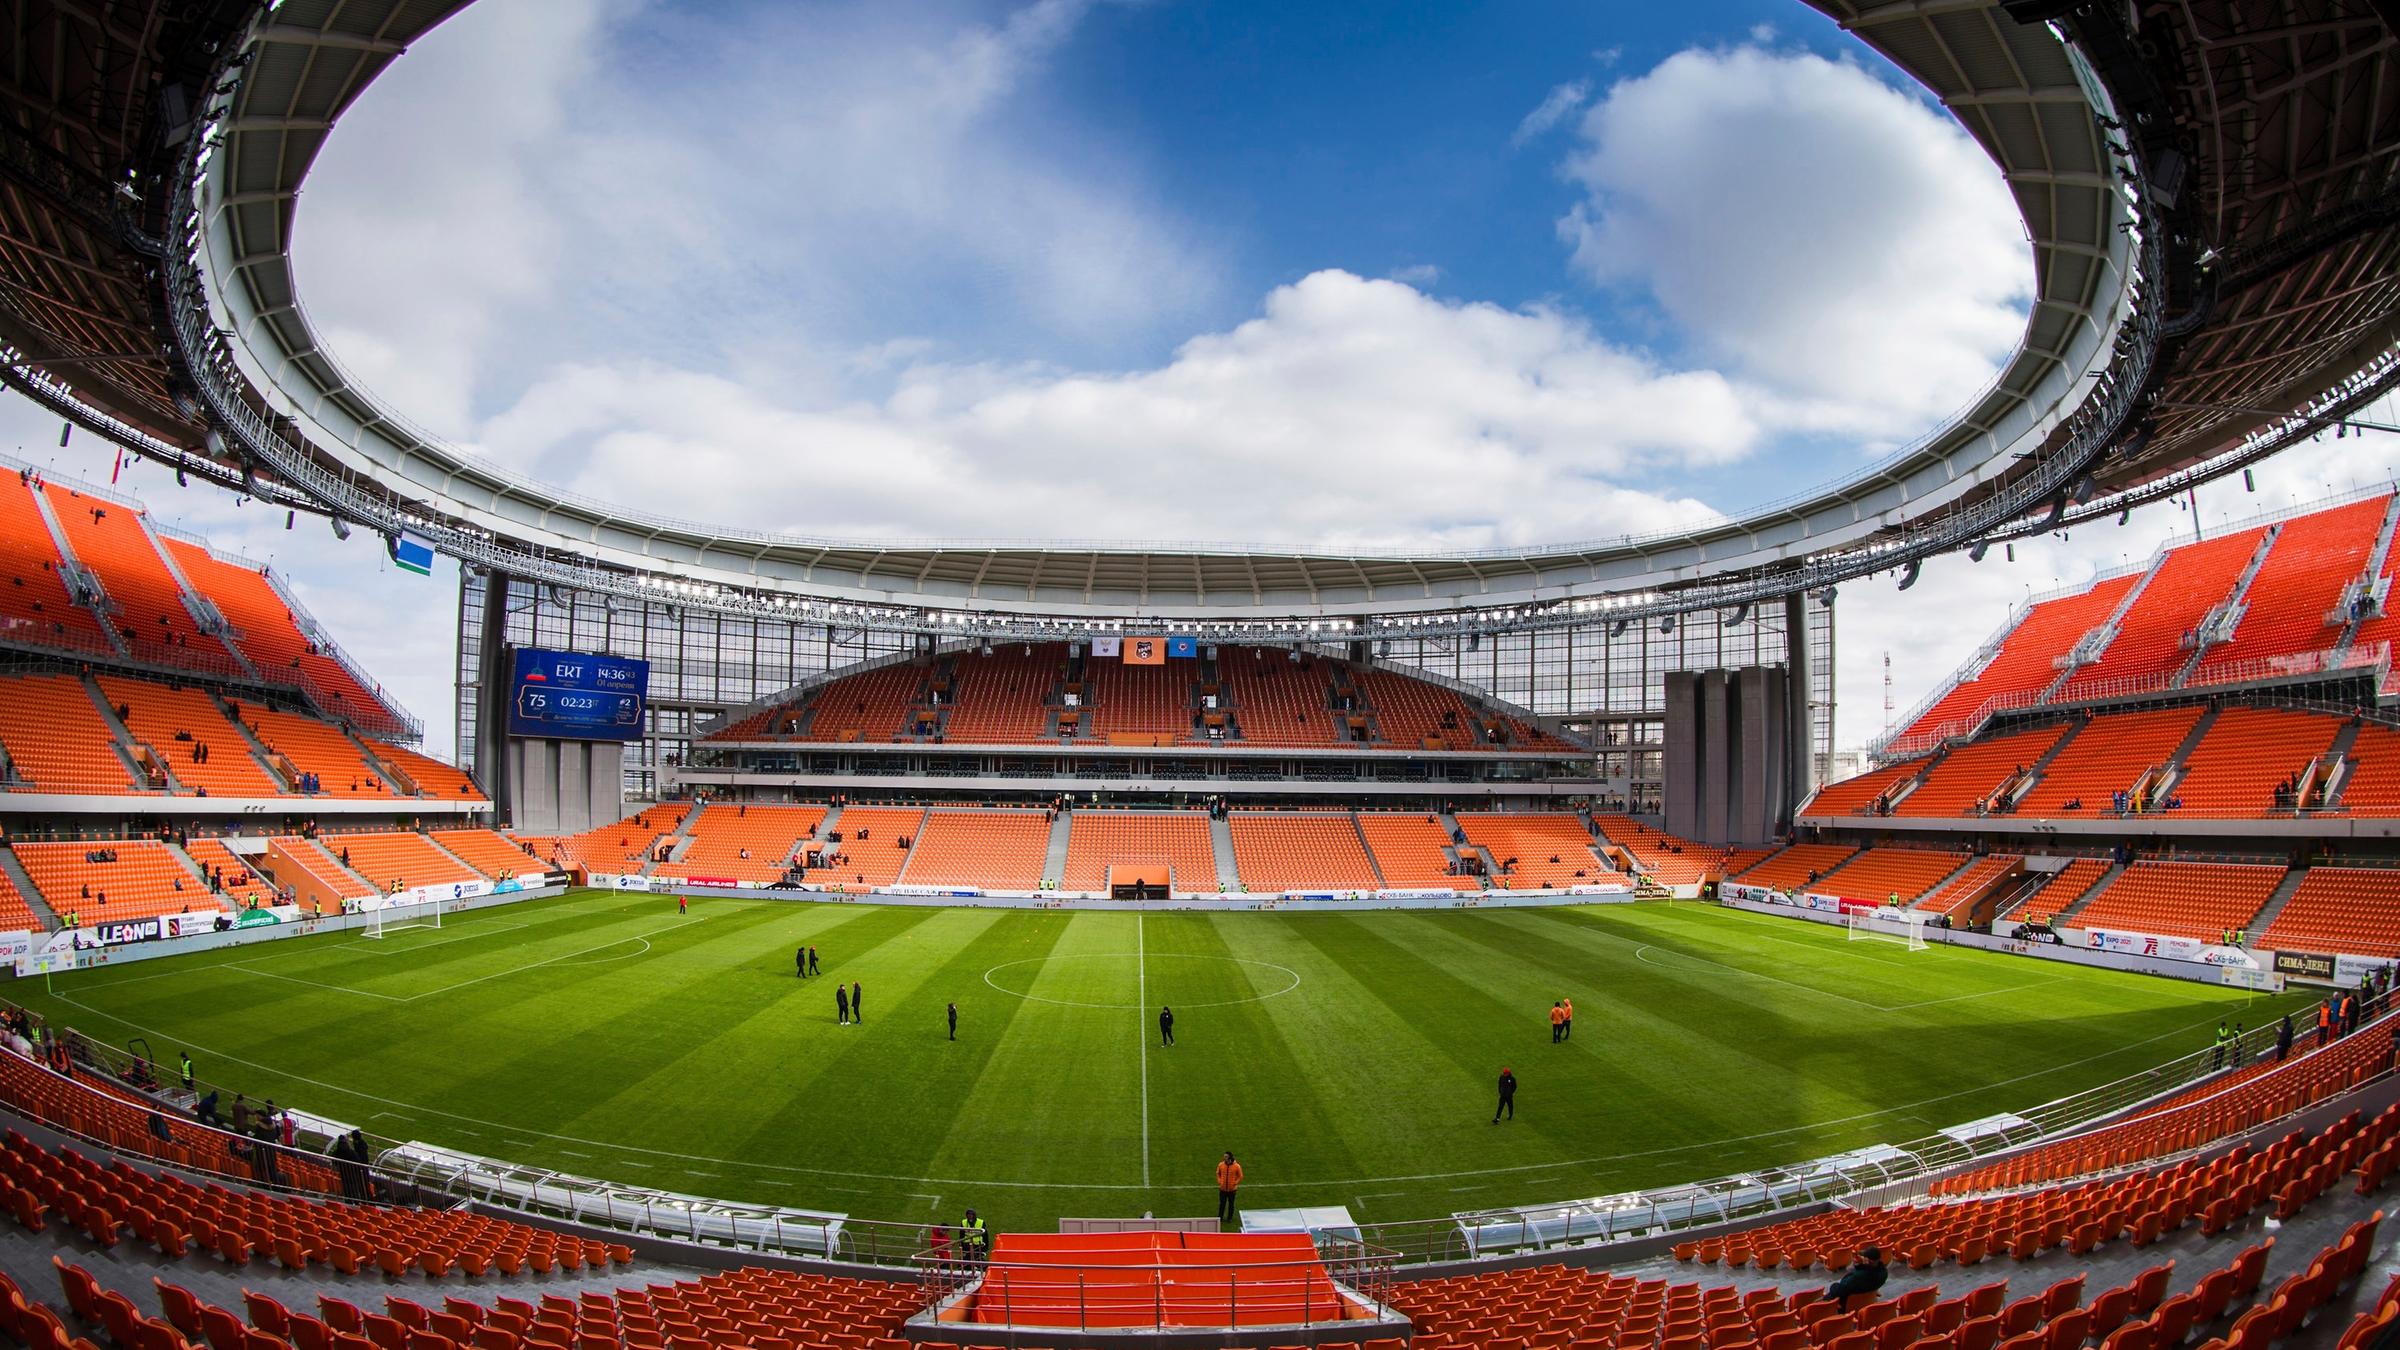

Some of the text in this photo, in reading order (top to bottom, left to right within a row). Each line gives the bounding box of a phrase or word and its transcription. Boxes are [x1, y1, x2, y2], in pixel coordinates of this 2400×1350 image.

[598, 668, 626, 680] 14:36
[529, 694, 546, 707] 75
[561, 697, 593, 709] 02:23
[102, 922, 145, 944] LEON
[2213, 954, 2247, 964] СКБ-БАНК
[2278, 956, 2330, 974] СИМА-ЛЕНД
